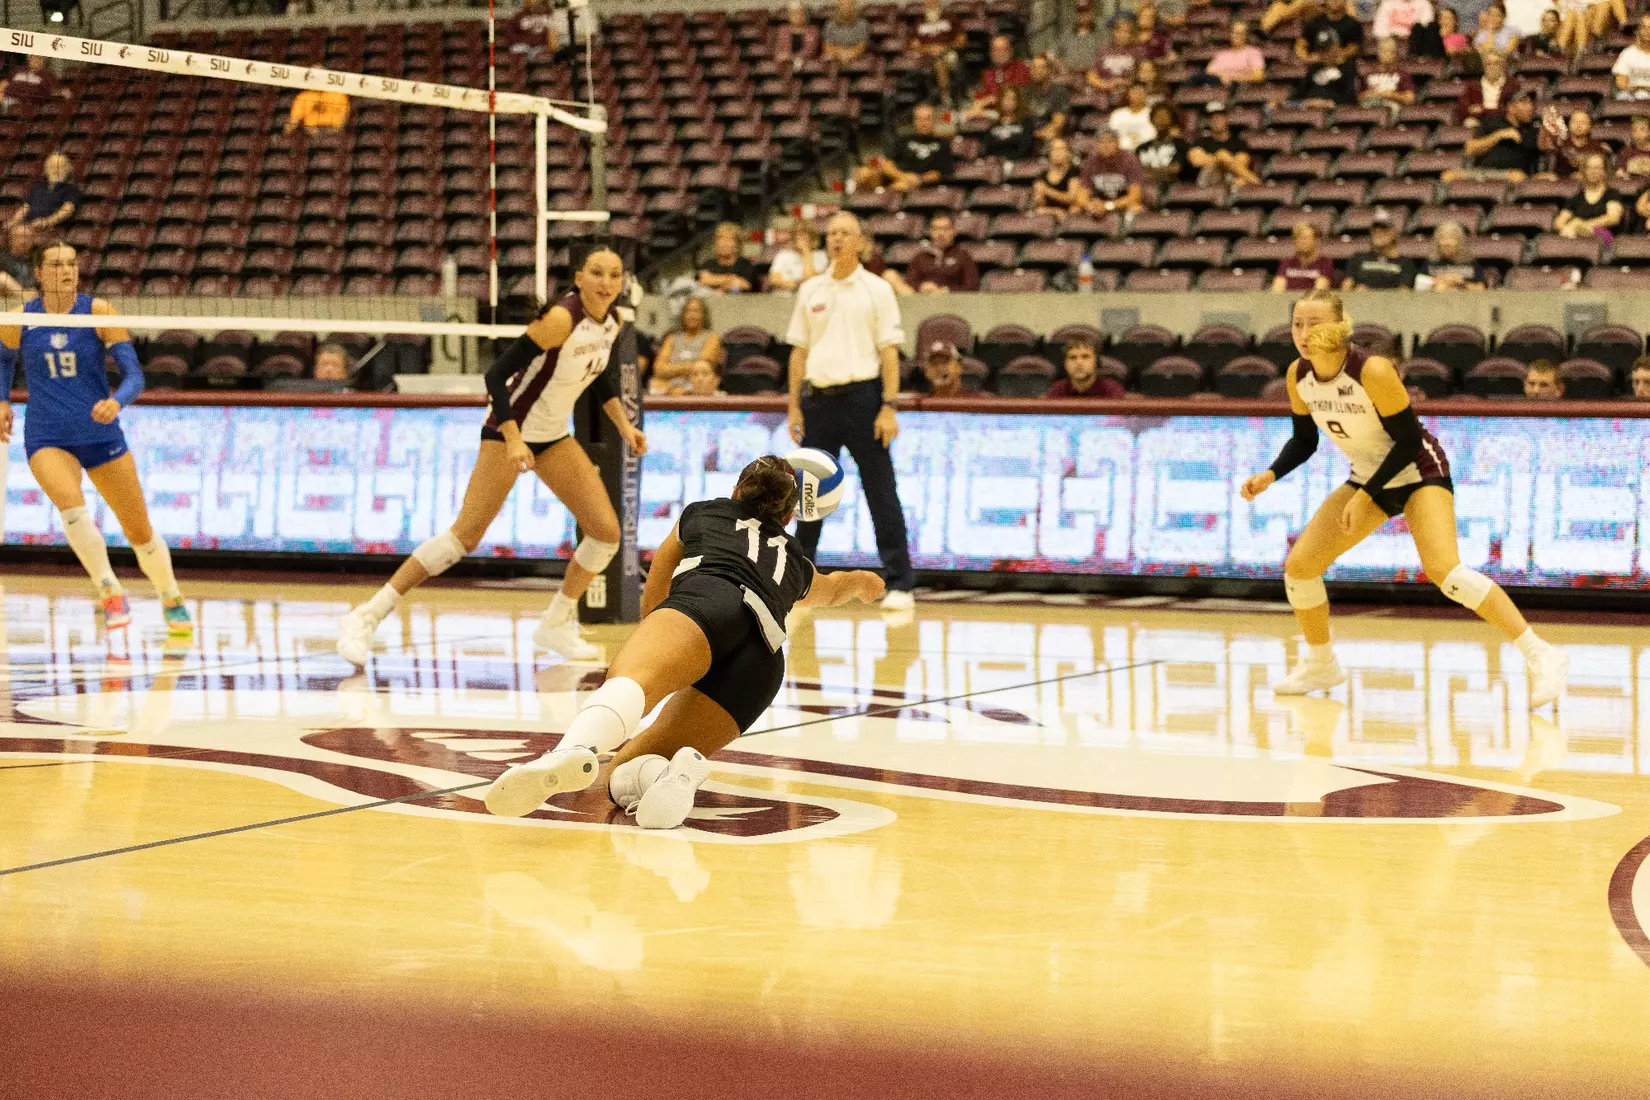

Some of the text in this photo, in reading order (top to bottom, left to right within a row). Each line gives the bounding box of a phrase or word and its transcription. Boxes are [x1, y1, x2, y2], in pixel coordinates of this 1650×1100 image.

[11, 32, 34, 48] SIU
[81, 41, 103, 57] SIU
[147, 49, 170, 64] SIU
[210, 58, 230, 72] SIU
[270, 66, 290, 80] SIU
[327, 73, 346, 86] SIU
[381, 80, 399, 93] SIU
[44, 351, 77, 379] 19
[1326, 420, 1351, 439] 9
[735, 517, 789, 586] 11
